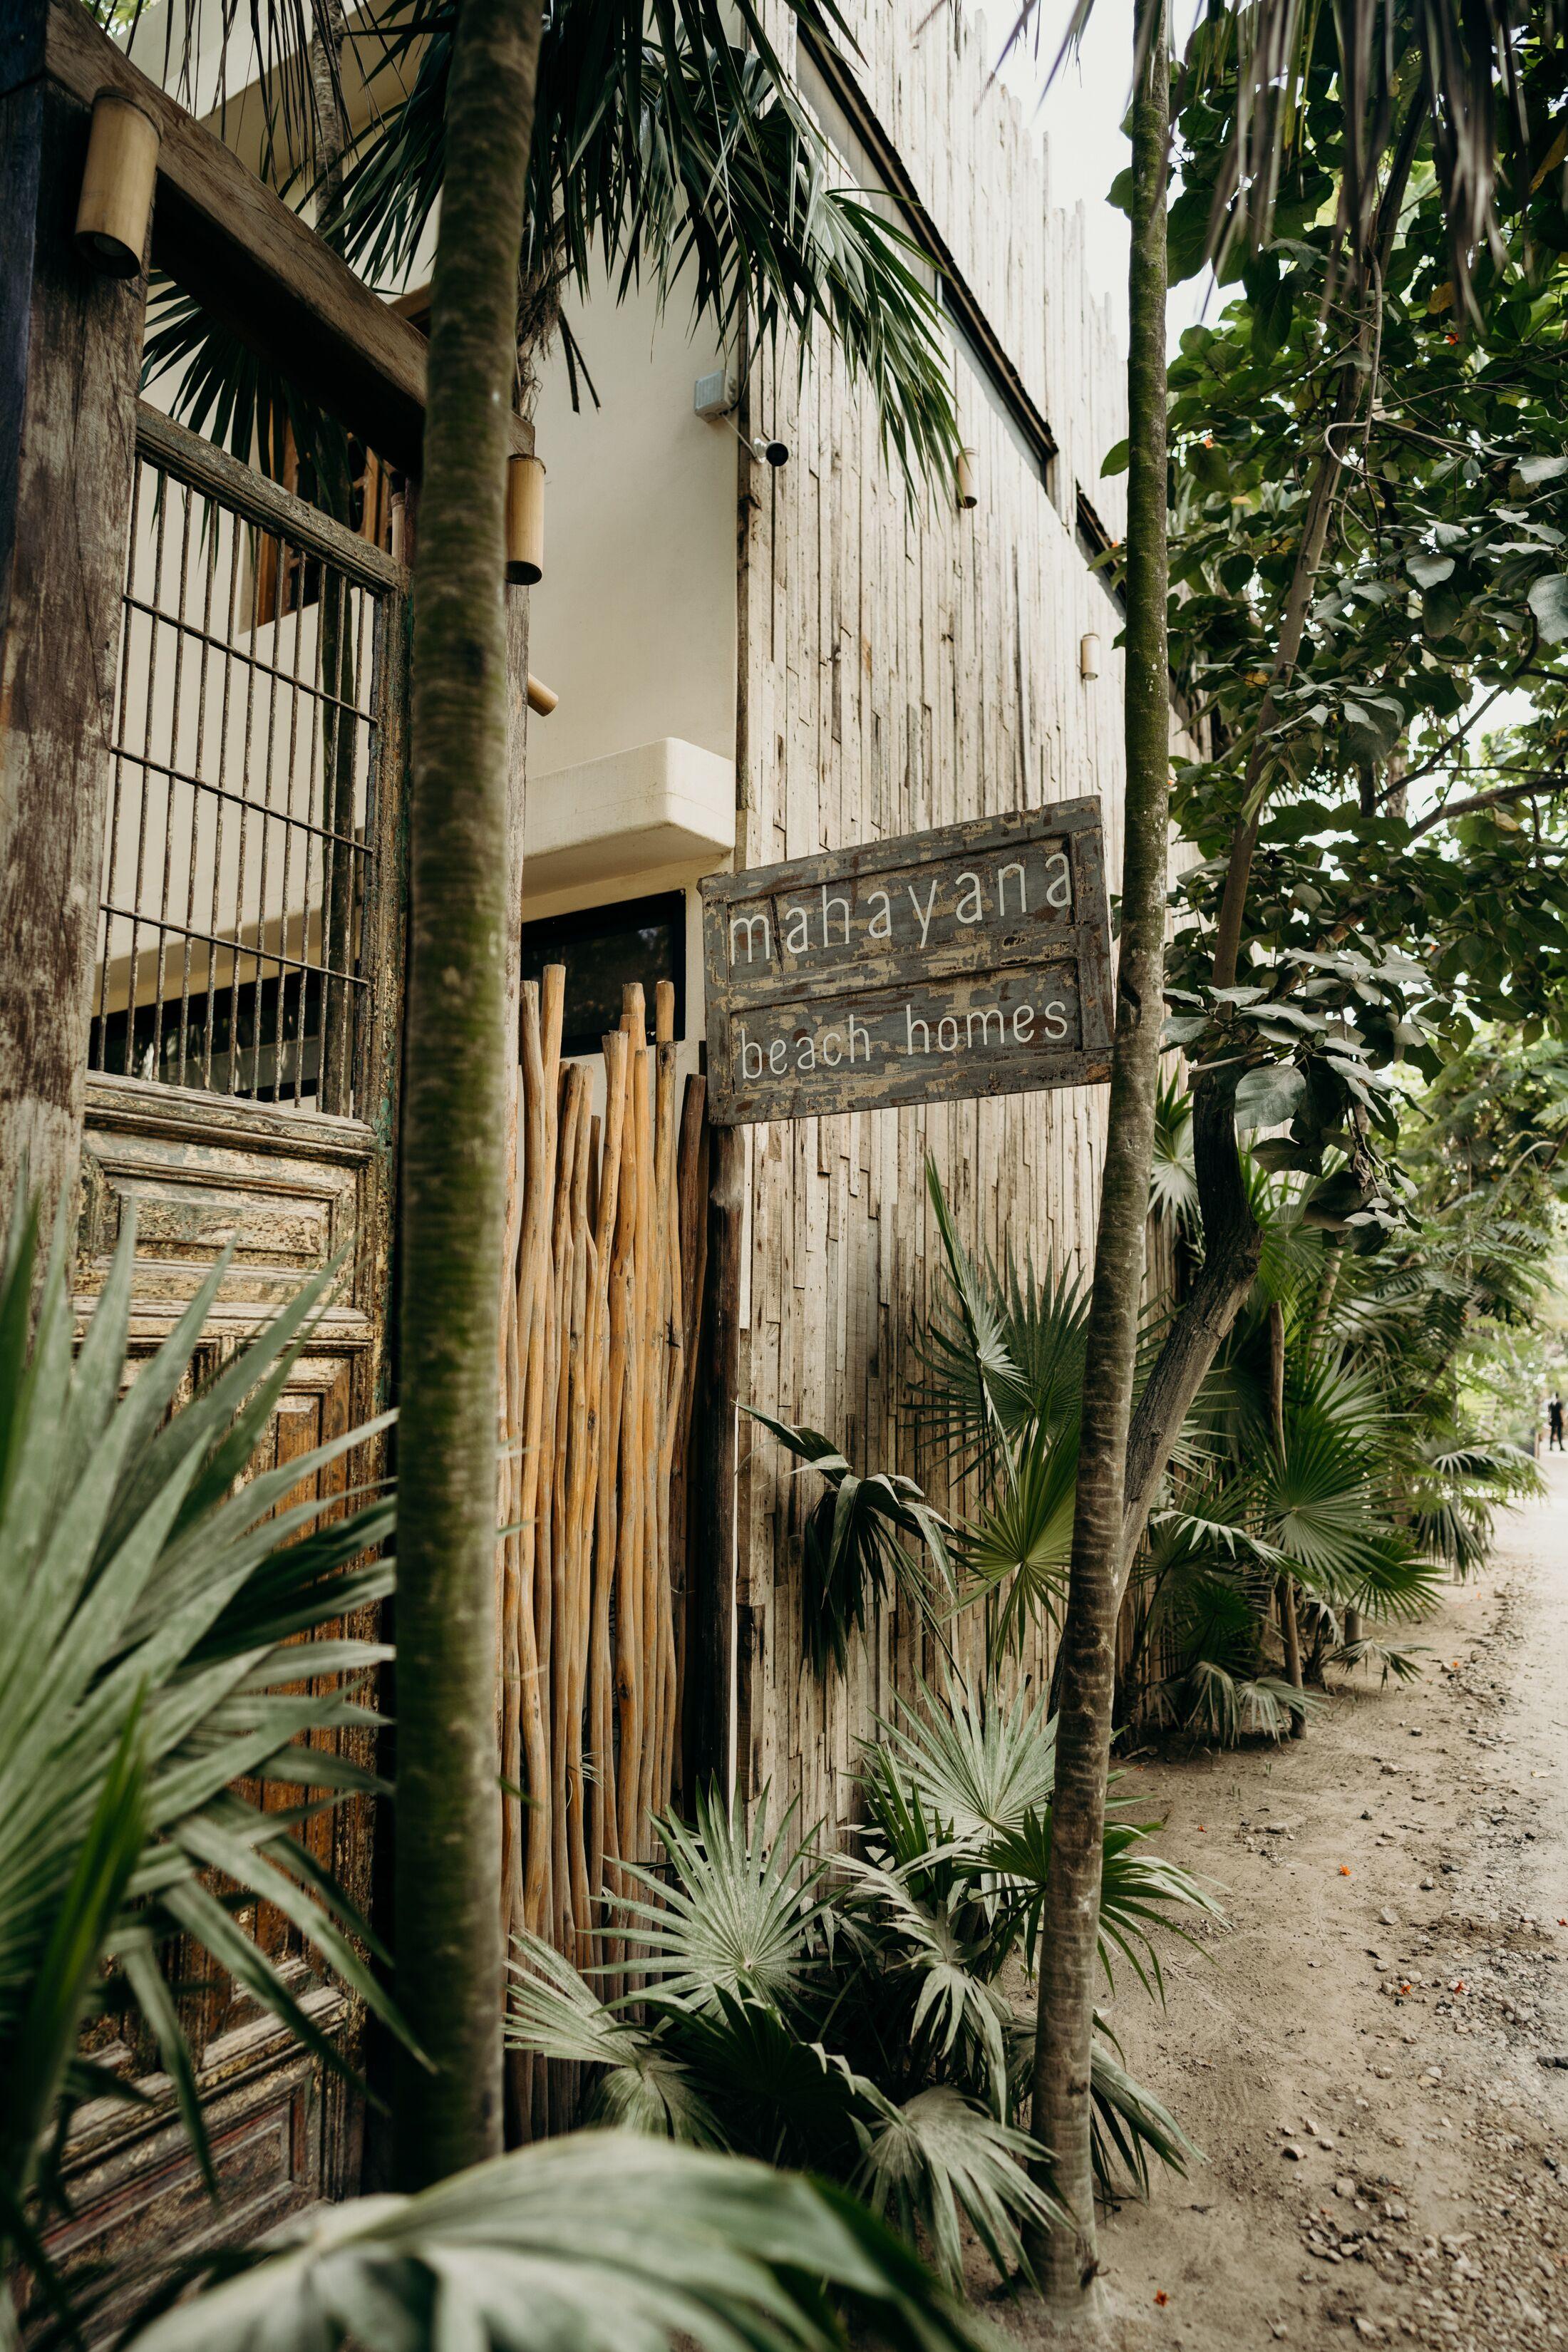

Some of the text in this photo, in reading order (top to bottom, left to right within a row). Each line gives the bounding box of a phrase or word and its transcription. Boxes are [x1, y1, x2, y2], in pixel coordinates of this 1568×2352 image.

[730, 853, 1072, 966] mahayana
[741, 1000, 1068, 1079] beach homes
